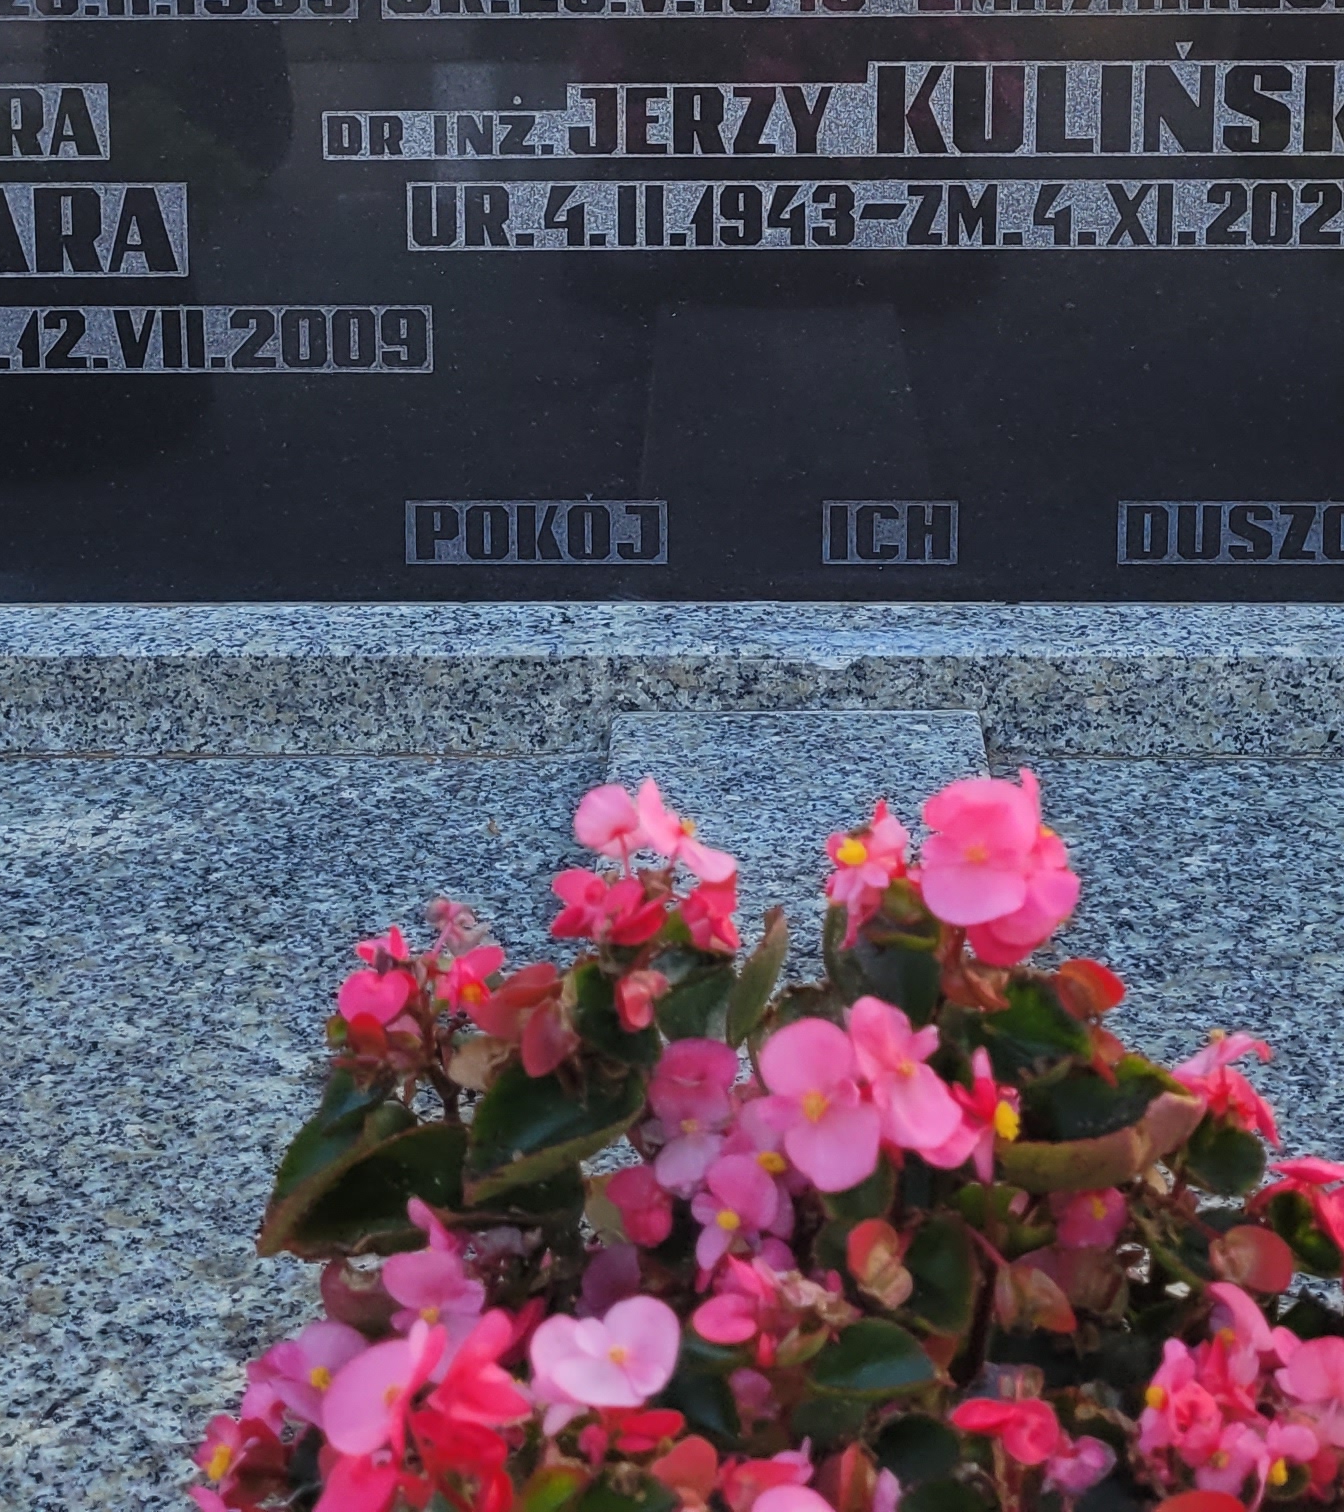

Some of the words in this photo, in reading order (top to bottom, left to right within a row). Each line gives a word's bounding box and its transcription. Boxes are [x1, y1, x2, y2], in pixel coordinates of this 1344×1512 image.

[327, 115, 404, 155] DR
[415, 494, 660, 561] POKÓJ
[828, 504, 953, 561] ICH
